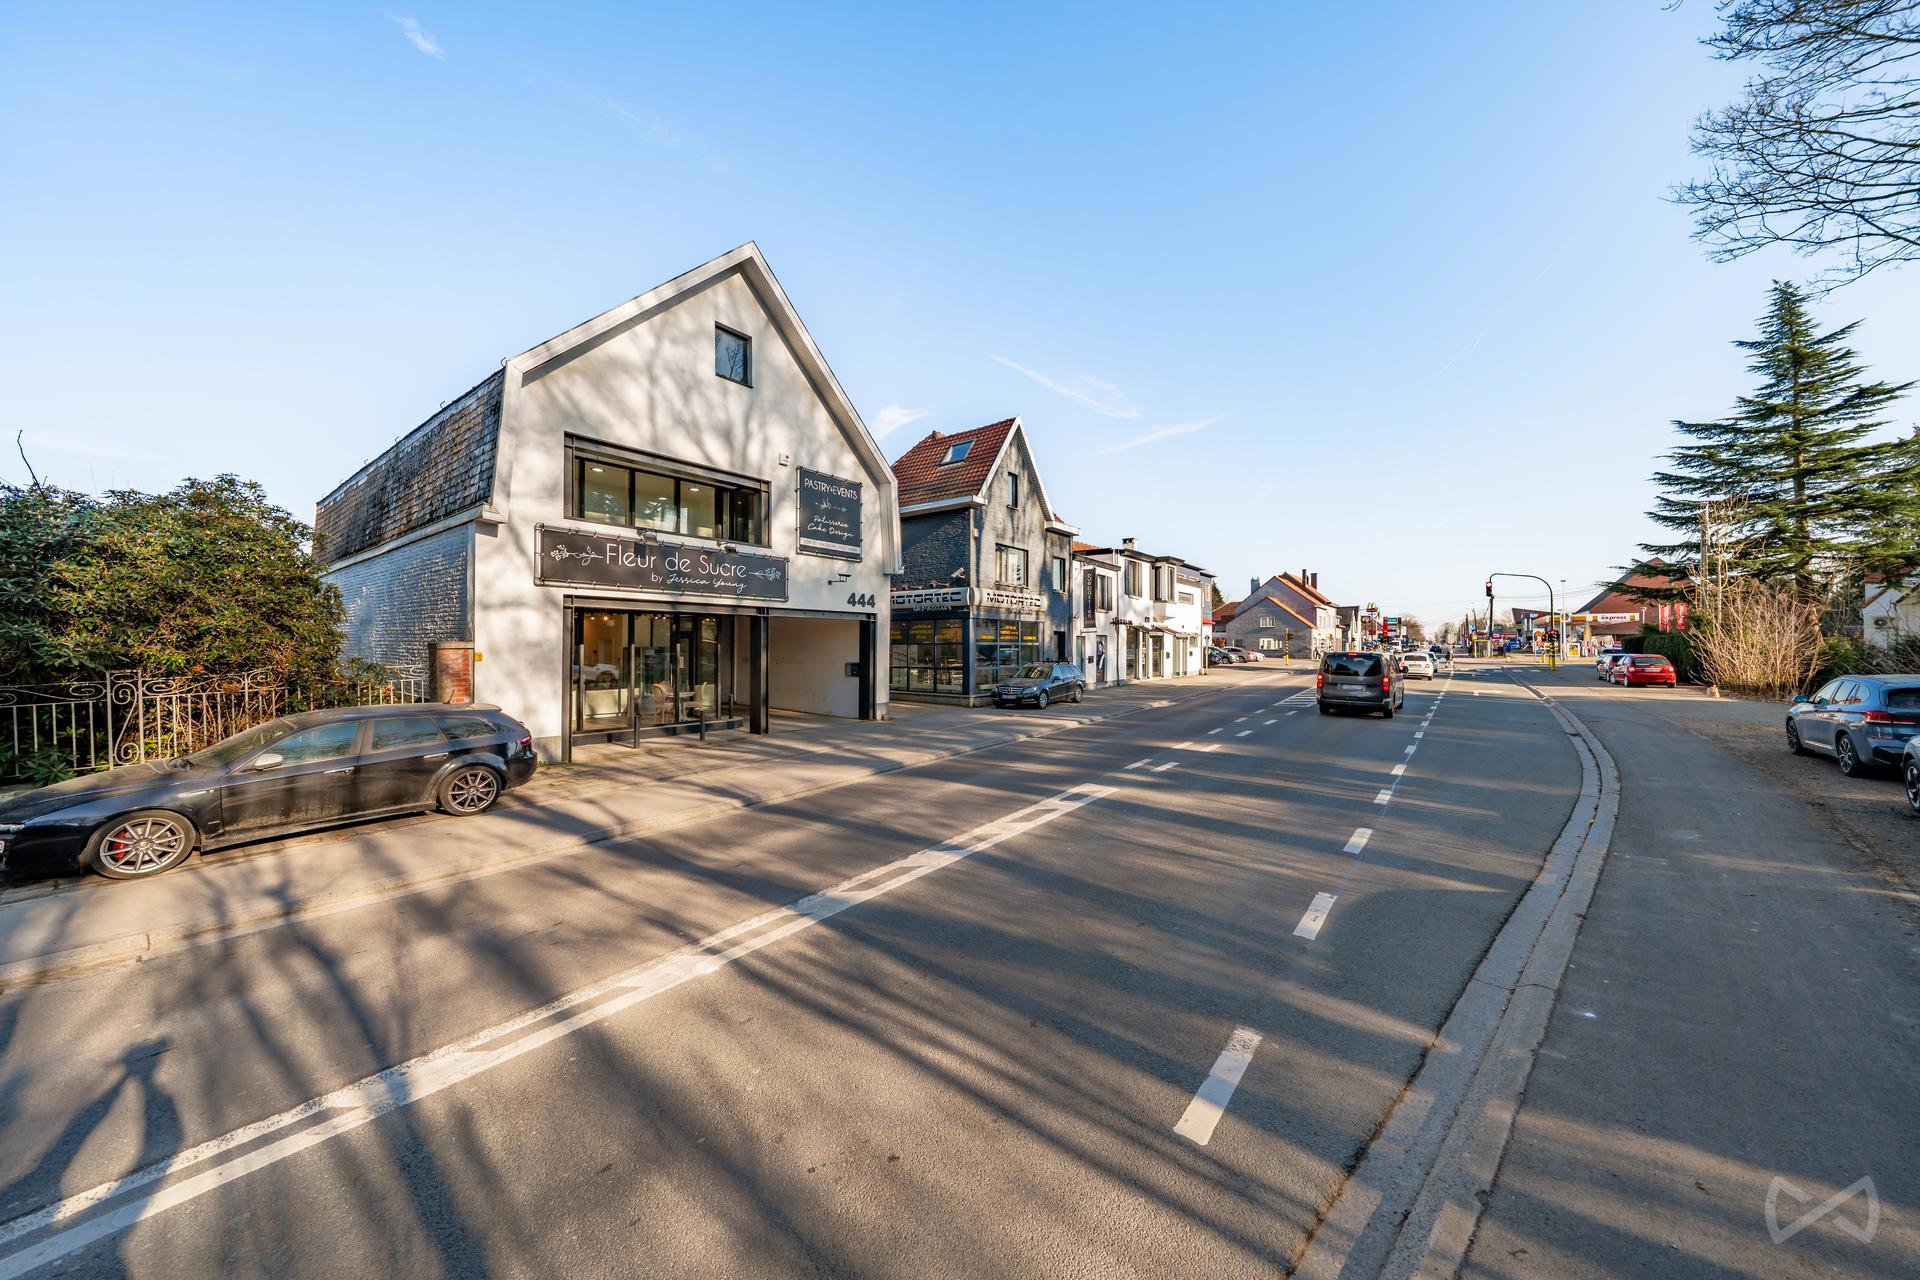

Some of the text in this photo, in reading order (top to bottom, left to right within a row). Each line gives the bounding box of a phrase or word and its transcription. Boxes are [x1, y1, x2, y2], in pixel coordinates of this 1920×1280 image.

[807, 523, 854, 539] Cake Design
[606, 543, 747, 577] Fleur de Sucre
[652, 572, 747, 593] by Jessica Young
[847, 592, 876, 608] 444
[986, 592, 1041, 607] MOTORTEC
